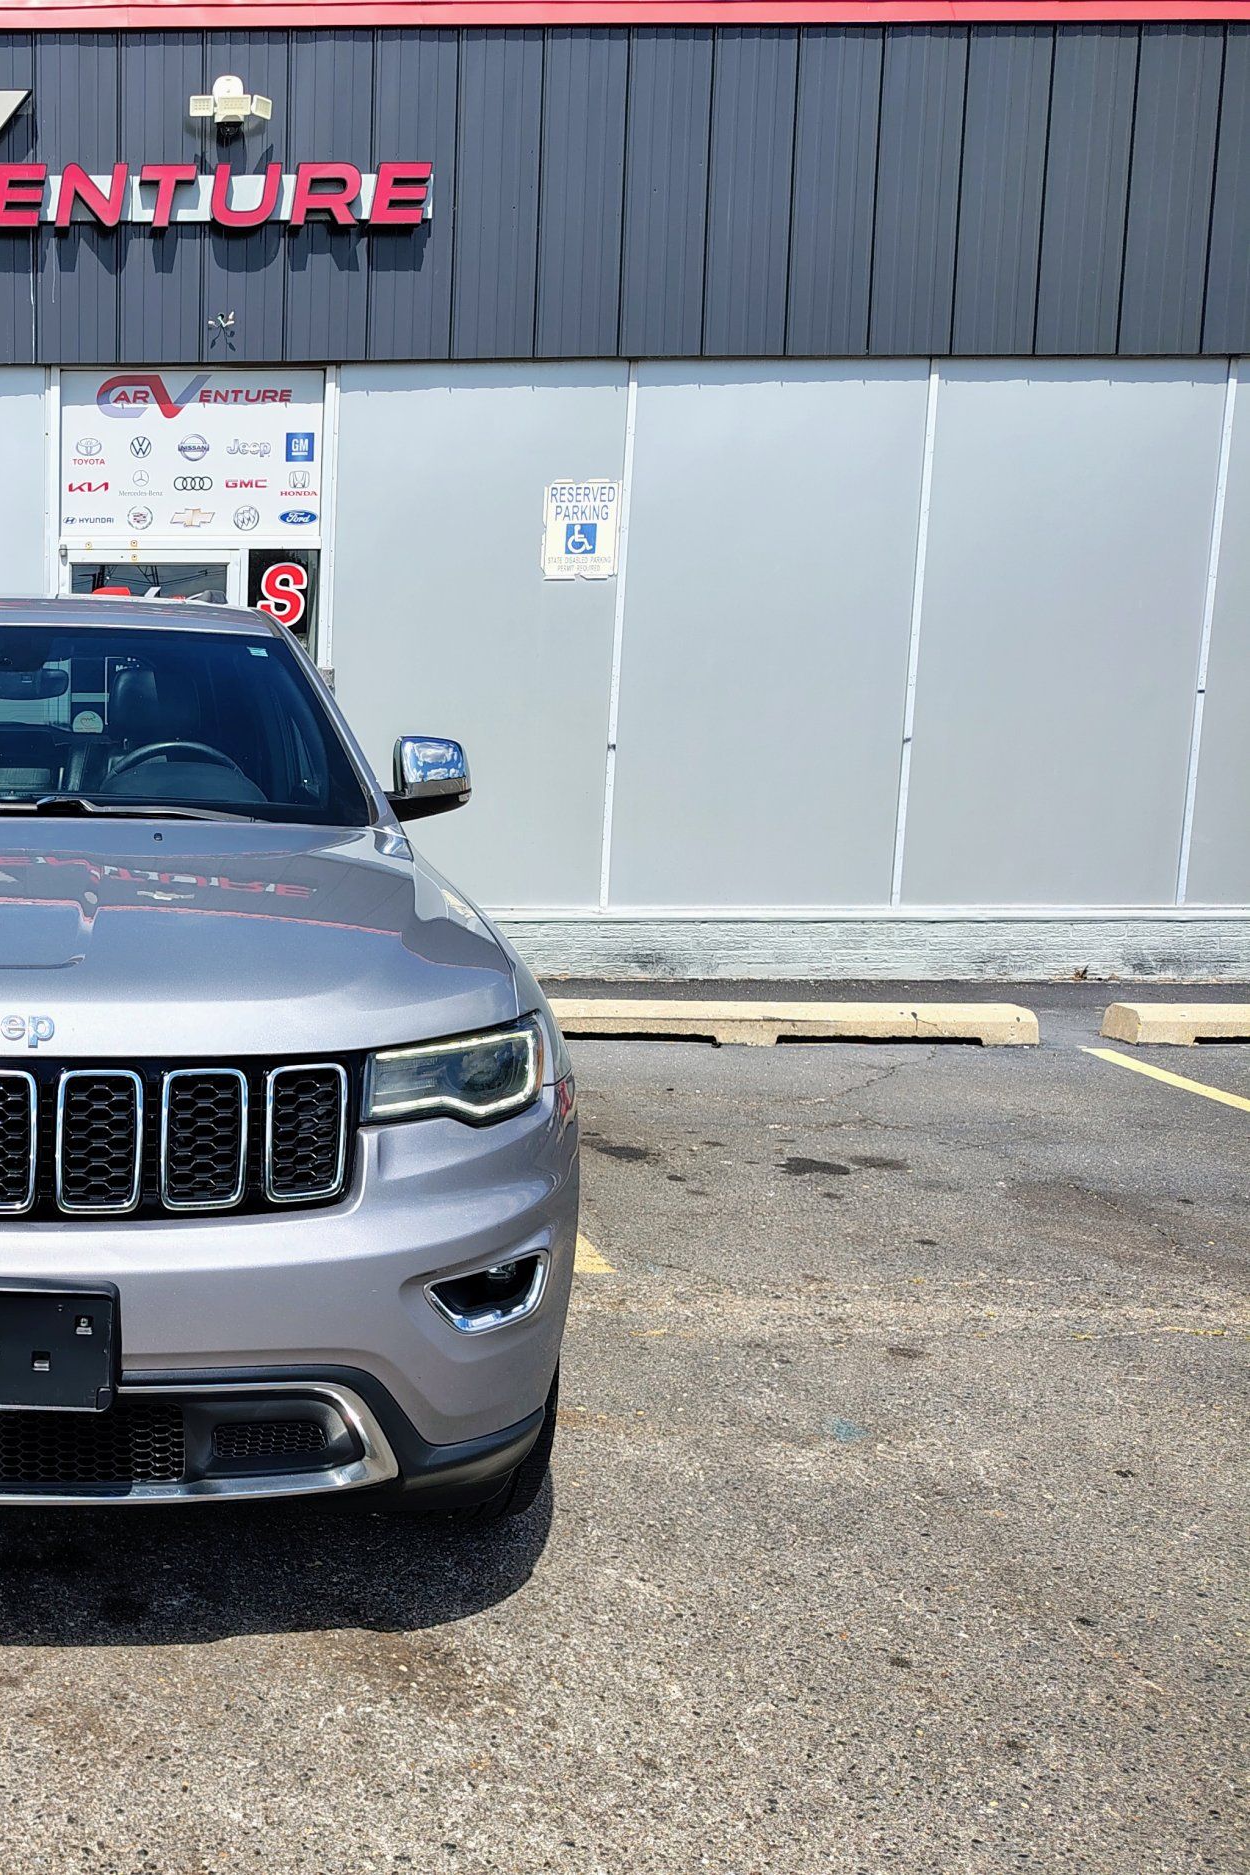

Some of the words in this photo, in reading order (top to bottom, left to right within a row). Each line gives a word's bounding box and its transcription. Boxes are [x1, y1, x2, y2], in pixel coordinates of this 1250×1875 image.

[226, 438, 272, 457] Jeep
[291, 438, 309, 452] GM
[224, 479, 268, 488] GMC
[550, 486, 616, 503] RESERVED
[285, 511, 311, 524] Ford
[555, 505, 609, 521] PARKING
